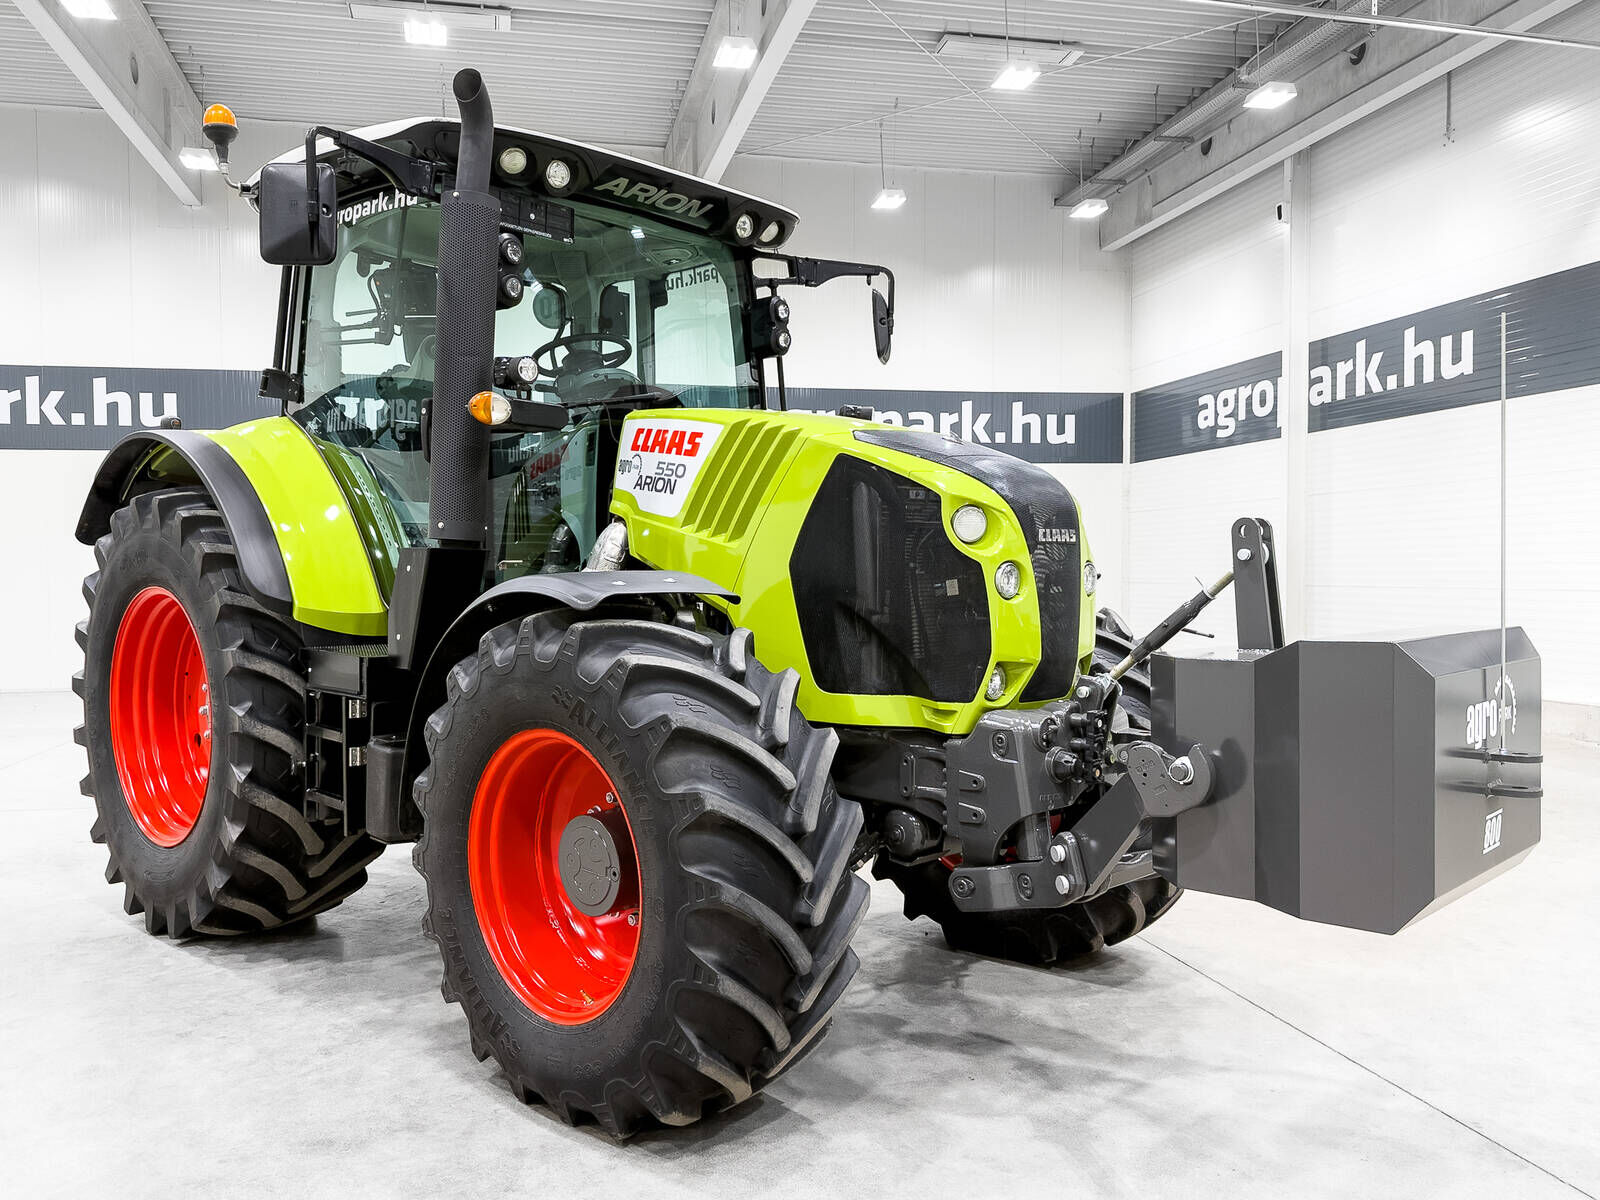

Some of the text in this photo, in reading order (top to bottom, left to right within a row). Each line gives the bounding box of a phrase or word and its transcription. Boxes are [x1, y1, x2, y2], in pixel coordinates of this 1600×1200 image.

[337, 188, 418, 228] ropark.hu
[594, 177, 714, 218] ARION
[631, 428, 703, 457] CLAAS
[633, 475, 677, 495] ARION
[655, 461, 686, 479] 550
[1038, 528, 1077, 542] CLAAS
[1466, 699, 1498, 750] agro
[1484, 813, 1502, 849] 800
